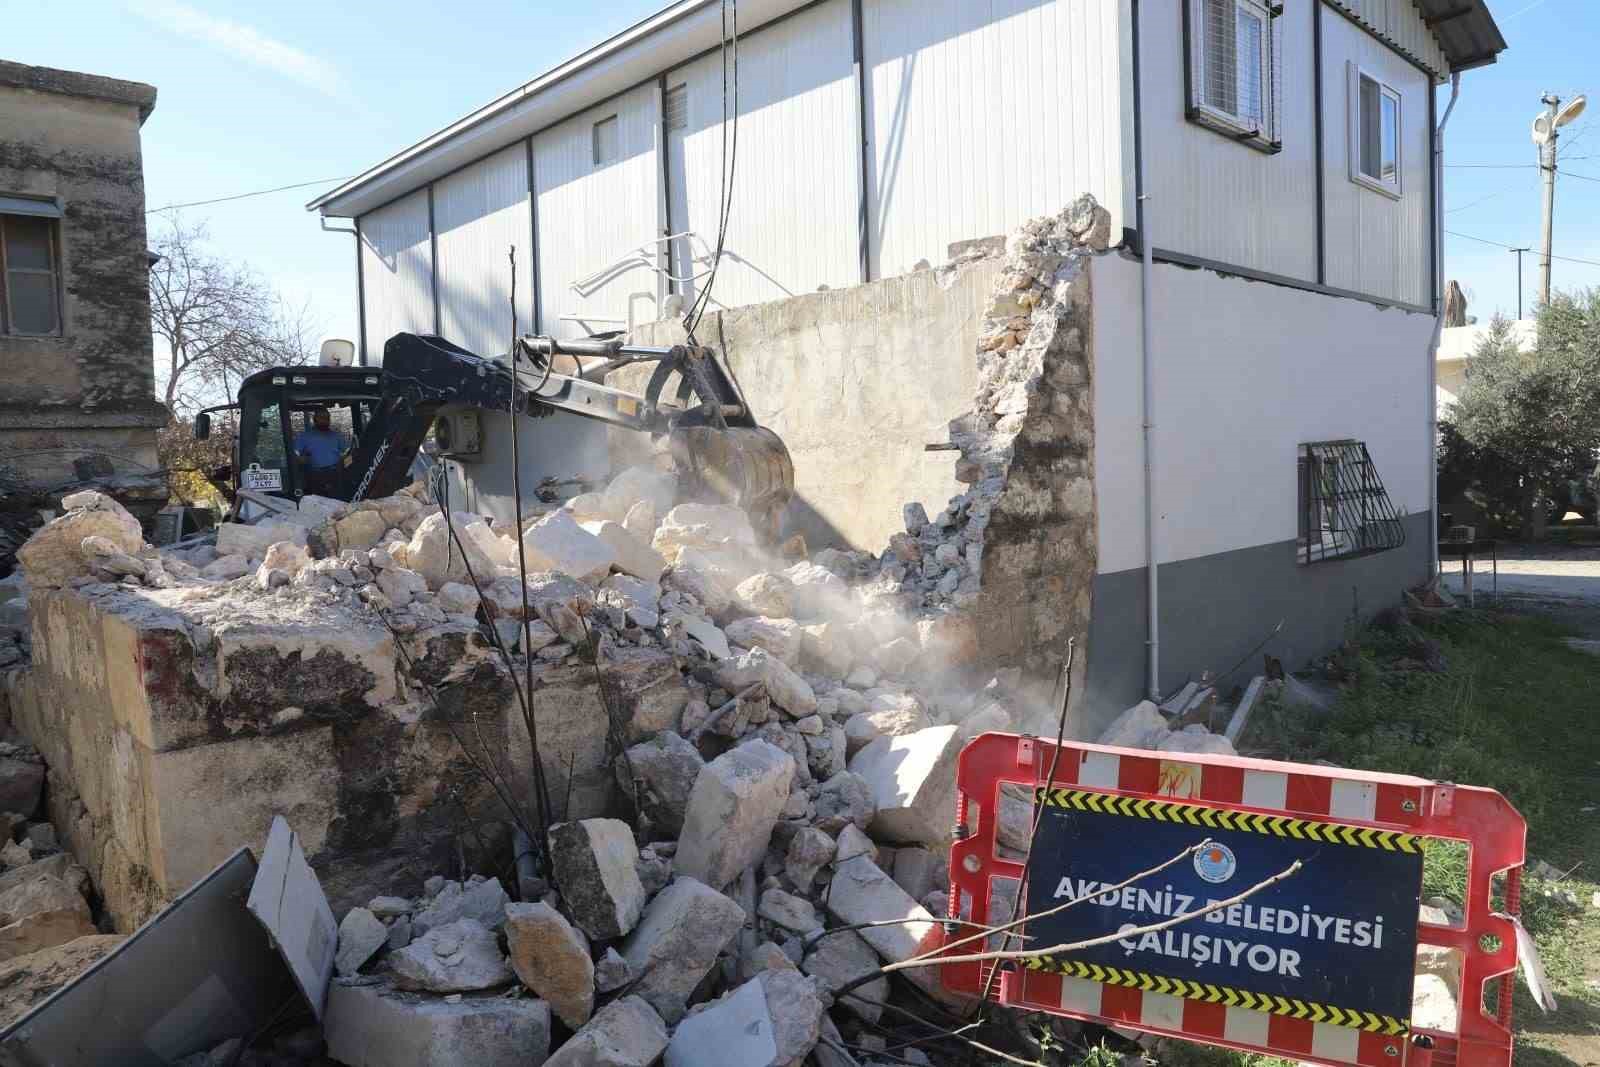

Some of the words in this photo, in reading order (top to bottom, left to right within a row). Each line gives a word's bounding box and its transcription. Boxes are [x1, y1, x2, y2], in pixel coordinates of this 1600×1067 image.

[1052, 876, 1195, 918] AKDENİZ
[1205, 899, 1384, 949] BELEDİYESİ
[1117, 923, 1301, 977] ÇALIŞIYOR
